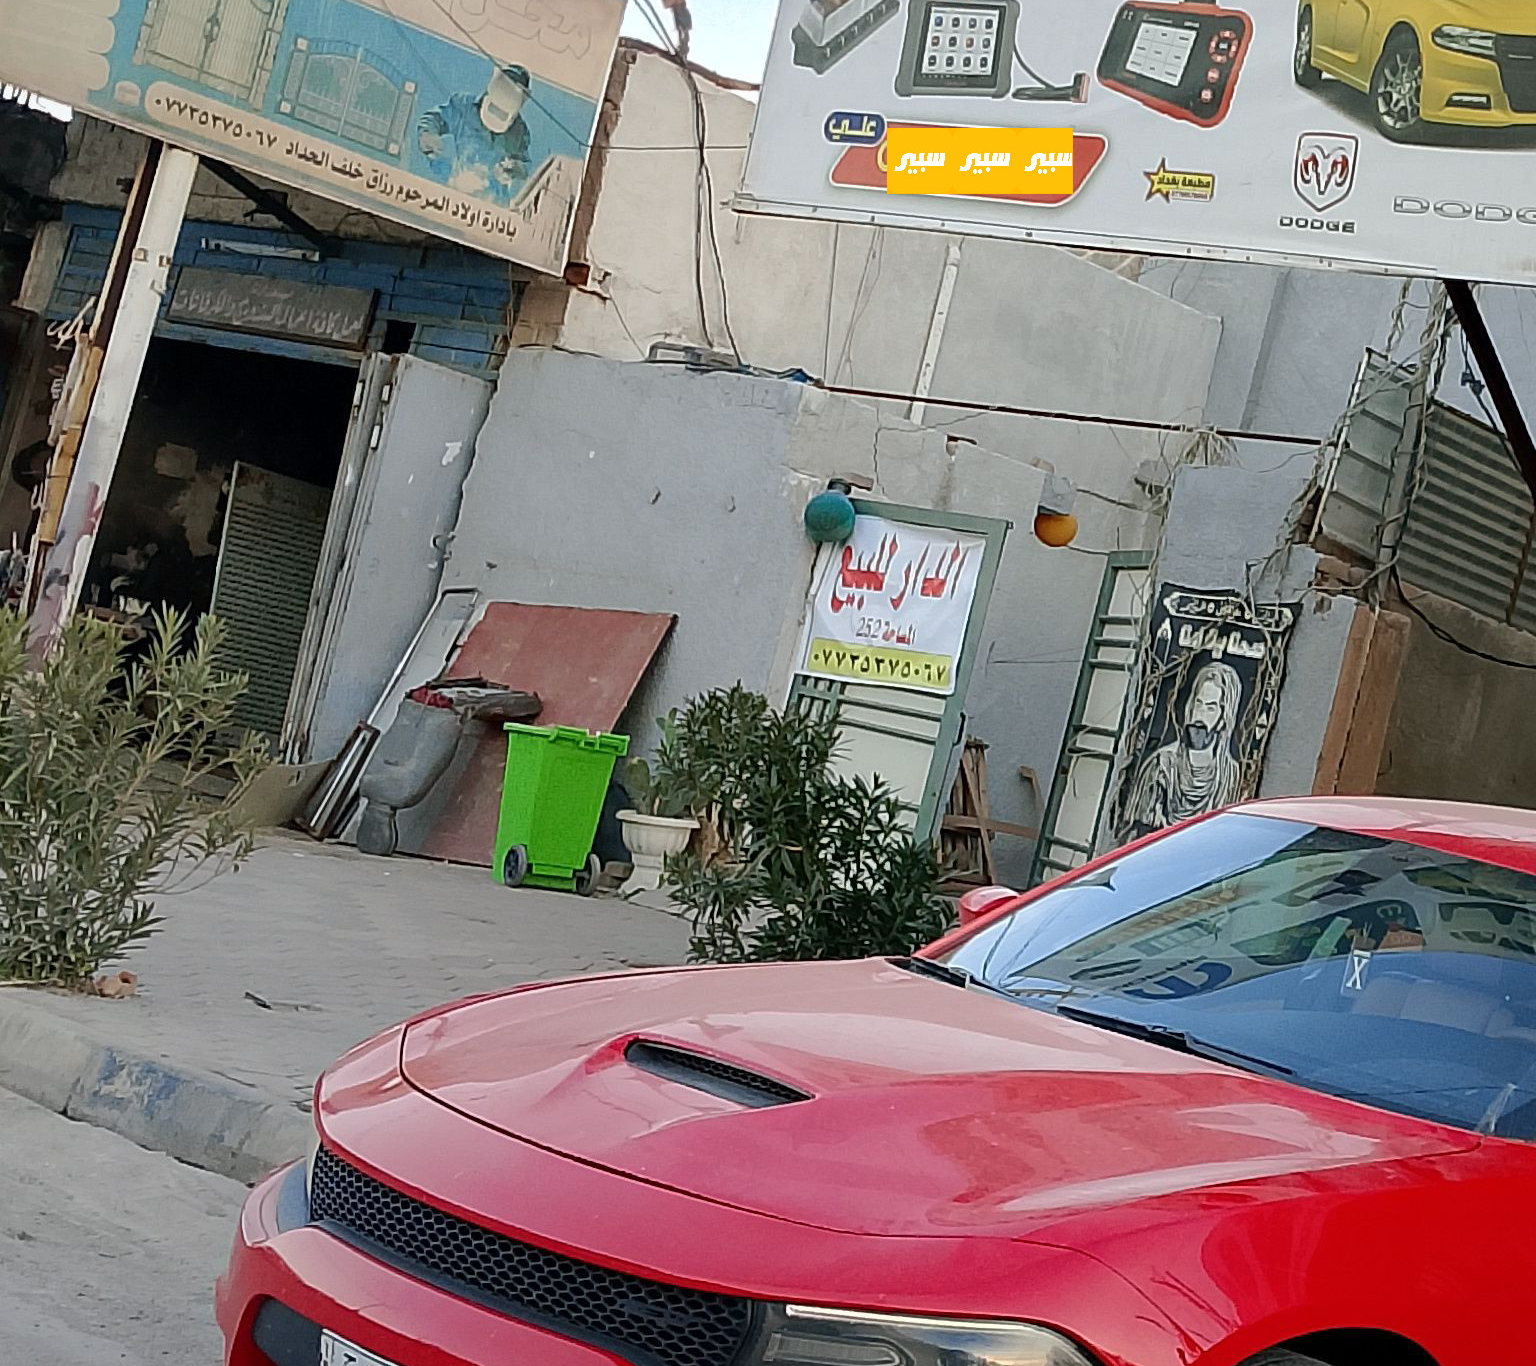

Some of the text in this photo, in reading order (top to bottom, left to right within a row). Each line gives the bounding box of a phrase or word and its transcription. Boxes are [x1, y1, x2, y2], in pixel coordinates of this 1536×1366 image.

[828, 115, 877, 140] علي
[284, 140, 330, 168] الحداد
[331, 157, 365, 181] خلف
[1279, 216, 1355, 233] DODGE
[830, 532, 970, 614] الدار للبيع
